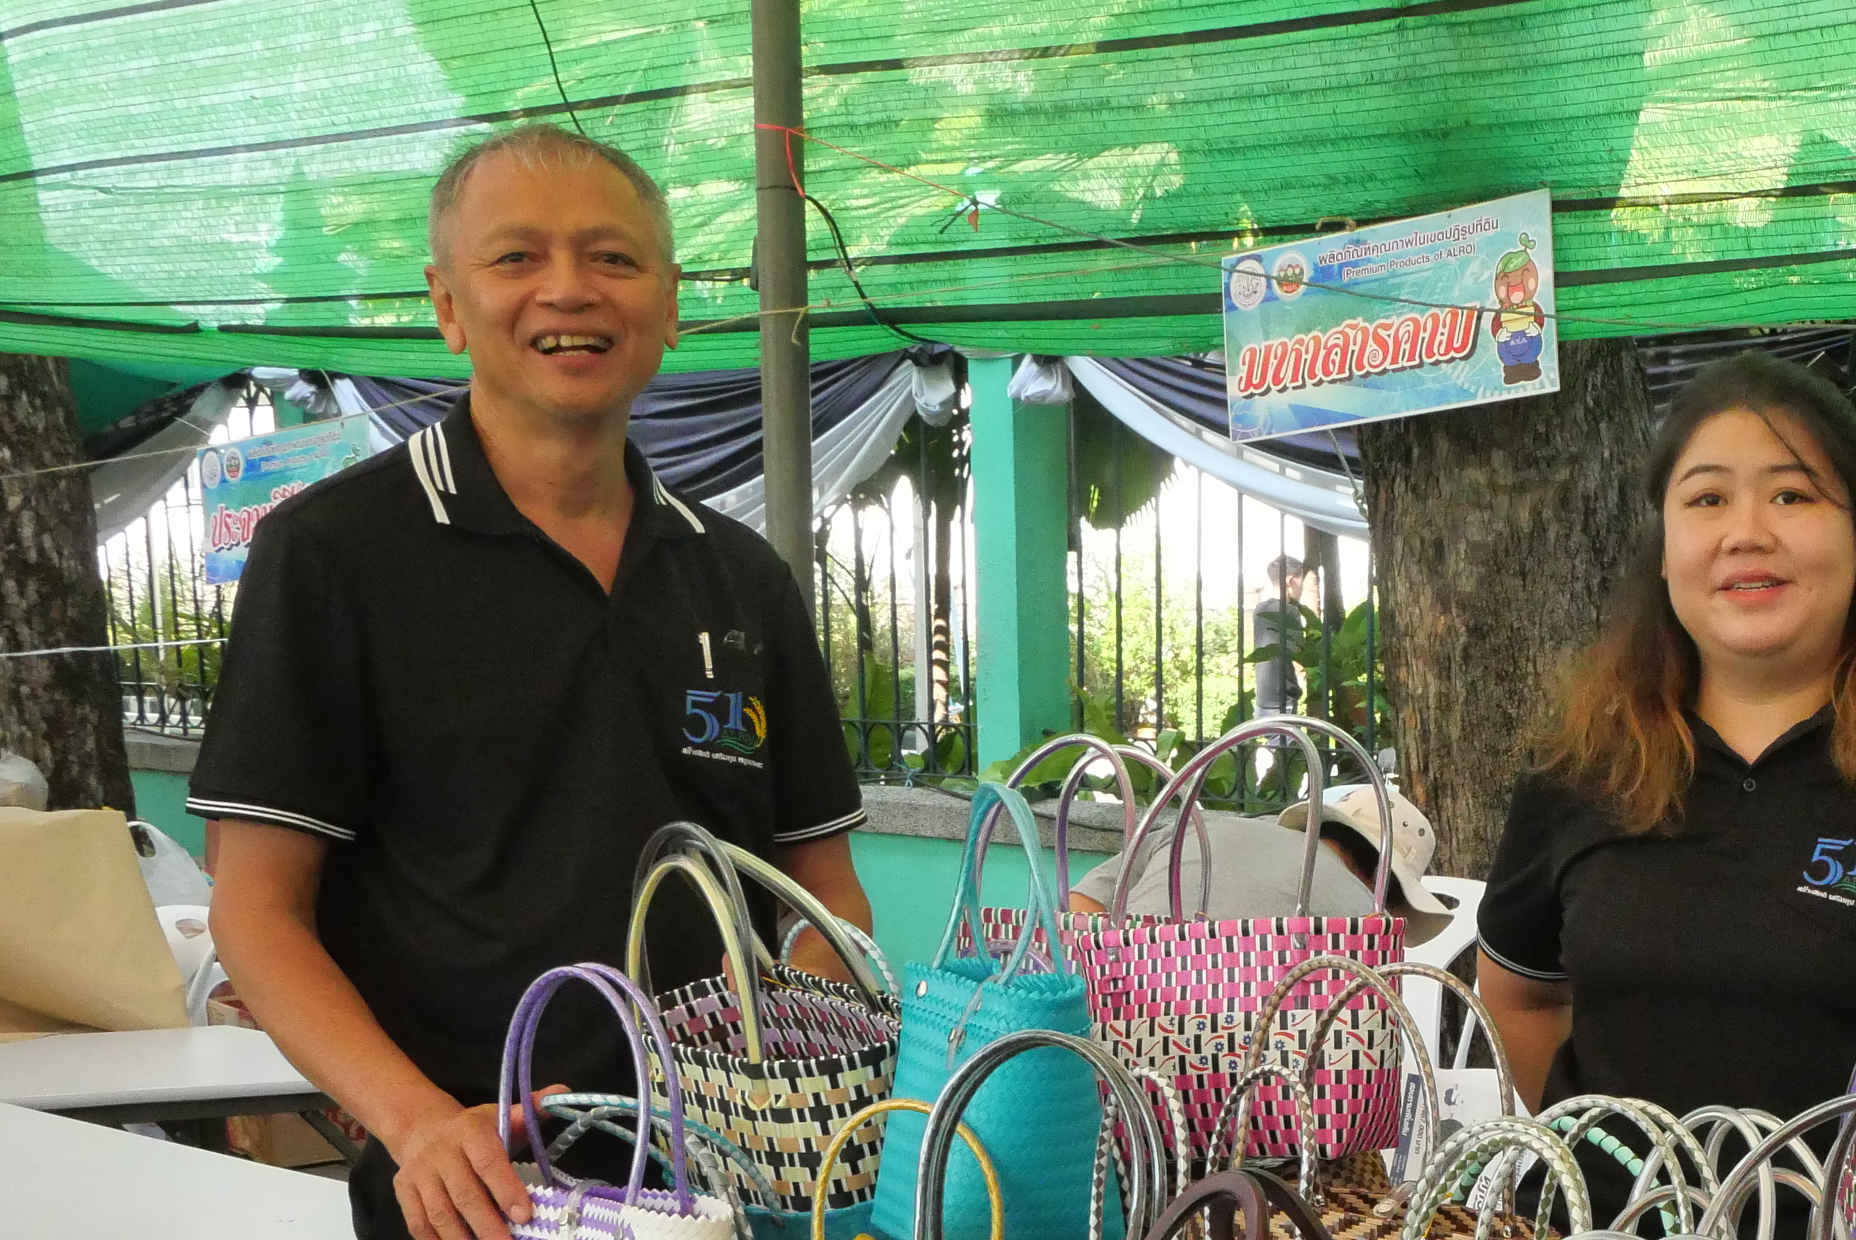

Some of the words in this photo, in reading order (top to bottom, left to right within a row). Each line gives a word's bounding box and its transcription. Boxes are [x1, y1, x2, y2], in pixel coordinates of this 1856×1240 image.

[1342, 263, 1386, 281] (Premium
[1390, 253, 1430, 271] Products
[1434, 251, 1443, 261] of
[1446, 243, 1476, 260] ALRO)
[1238, 303, 1481, 395] มหาสารคาม
[682, 690, 747, 743] 51
